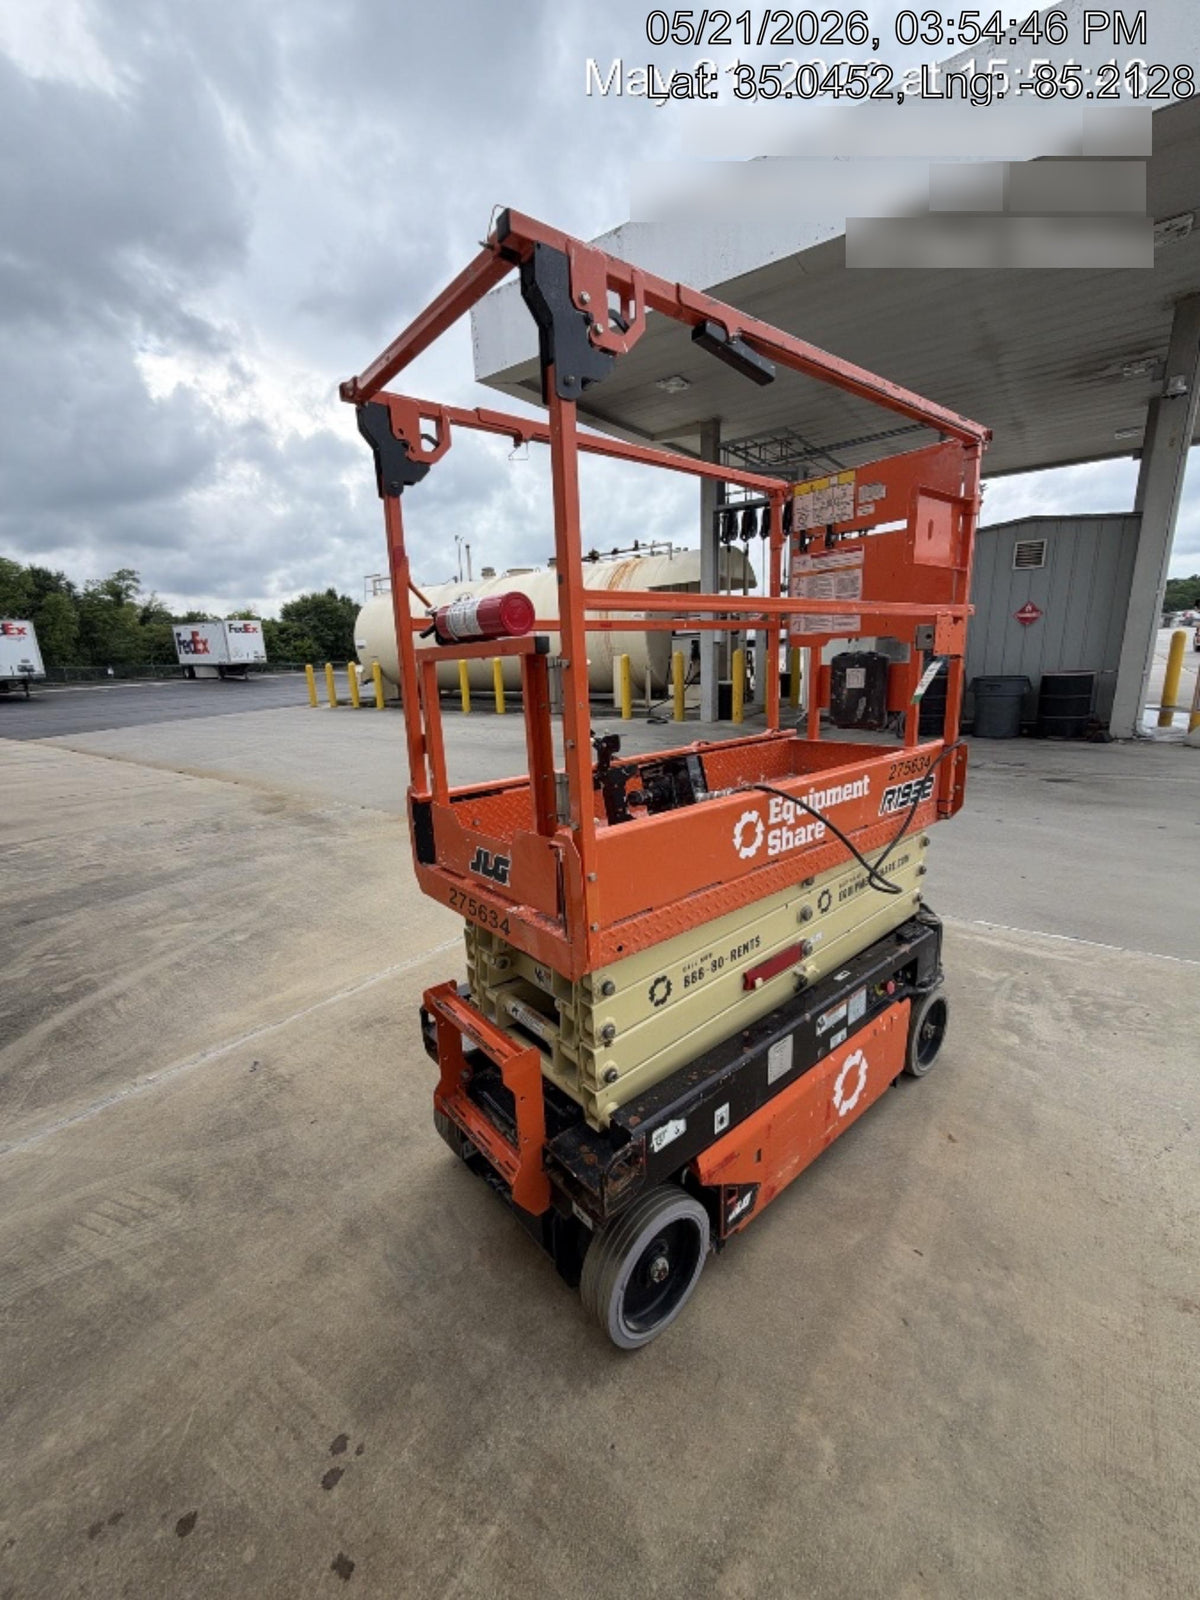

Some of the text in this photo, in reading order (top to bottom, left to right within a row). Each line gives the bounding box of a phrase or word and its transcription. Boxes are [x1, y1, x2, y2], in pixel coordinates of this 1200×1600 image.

[176, 631, 210, 654] FedEx
[228, 623, 258, 633] FedEx
[889, 755, 931, 781] 275634
[768, 775, 870, 825] Equipment
[768, 819, 827, 856] Share
[470, 847, 511, 887] JLG
[449, 887, 511, 936] 275634
